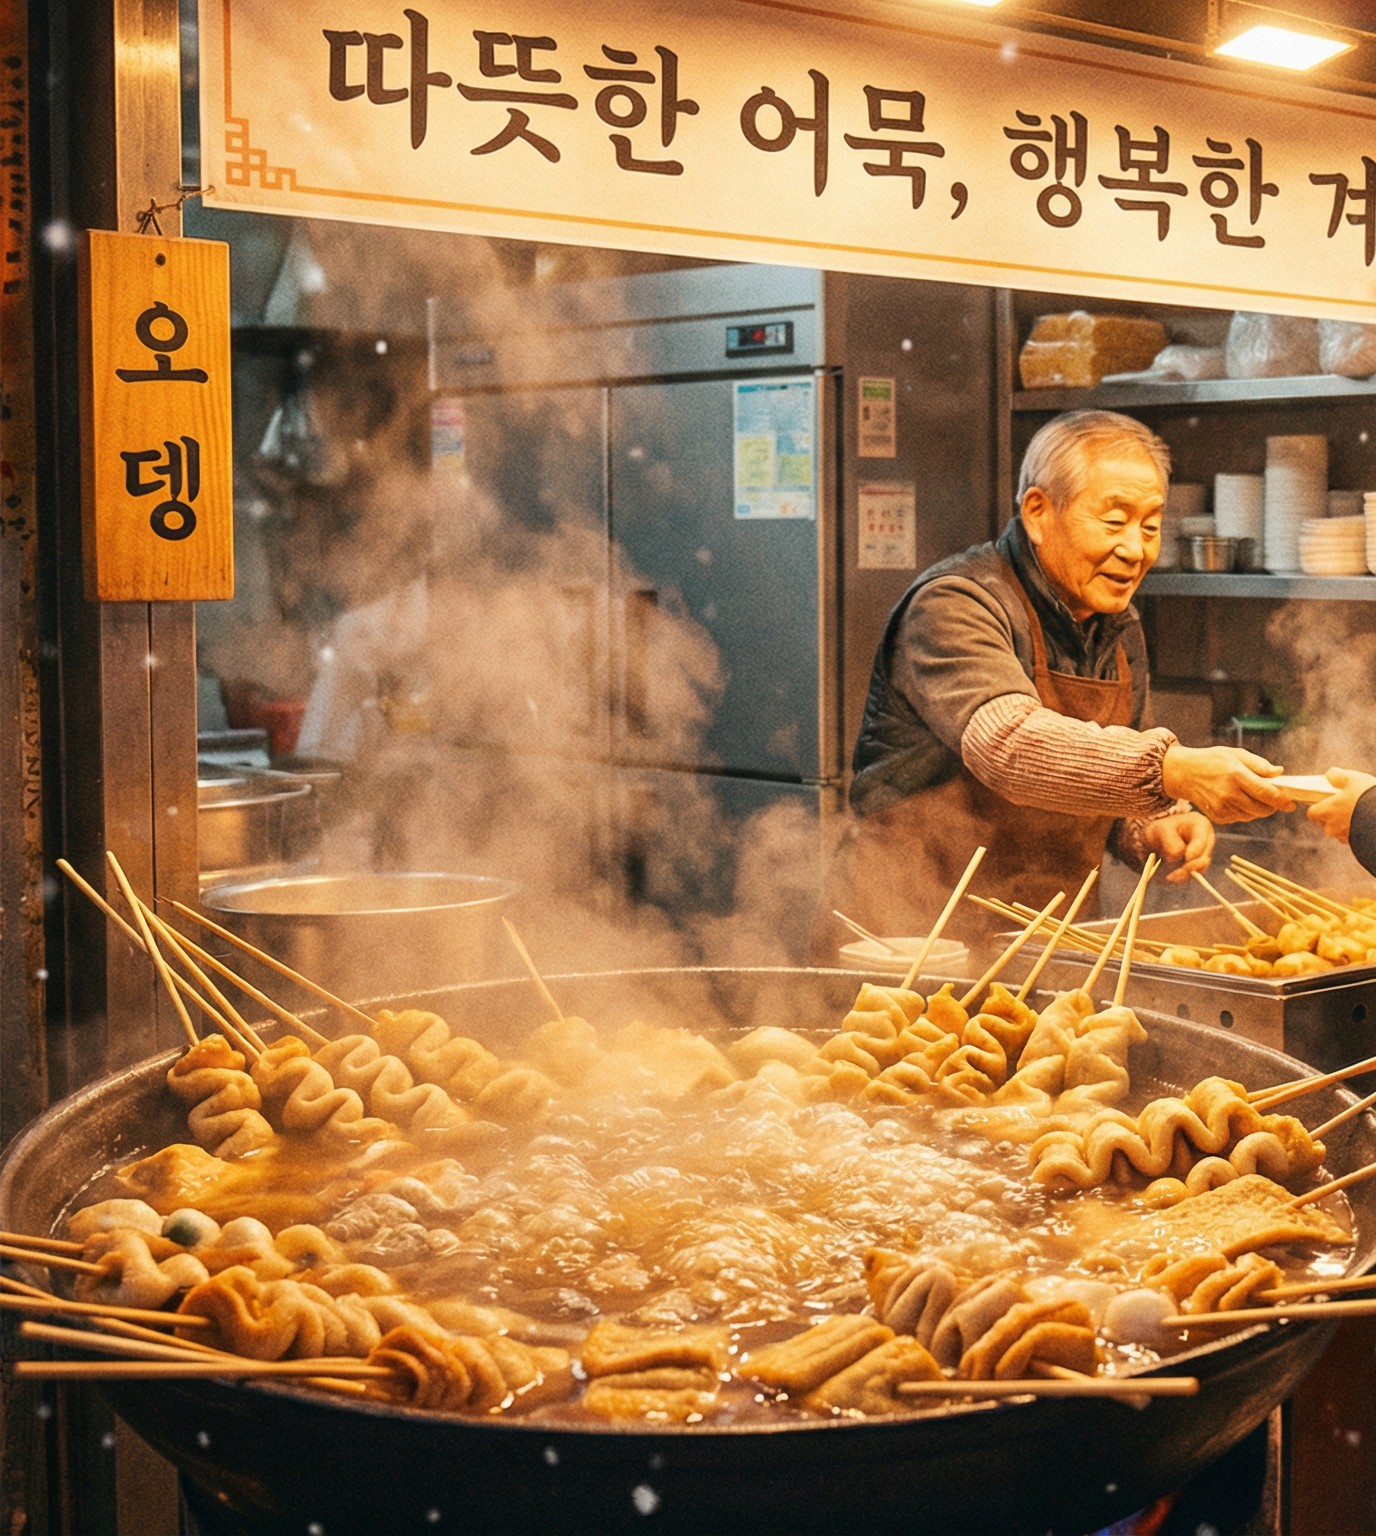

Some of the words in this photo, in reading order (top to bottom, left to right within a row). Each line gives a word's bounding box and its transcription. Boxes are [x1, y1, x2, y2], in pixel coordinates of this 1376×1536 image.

[322, 8, 699, 175] 따뜻한
[740, 69, 968, 220] 어묵,
[1003, 109, 1280, 248] 행복한
[116, 301, 208, 541] 오뎅
